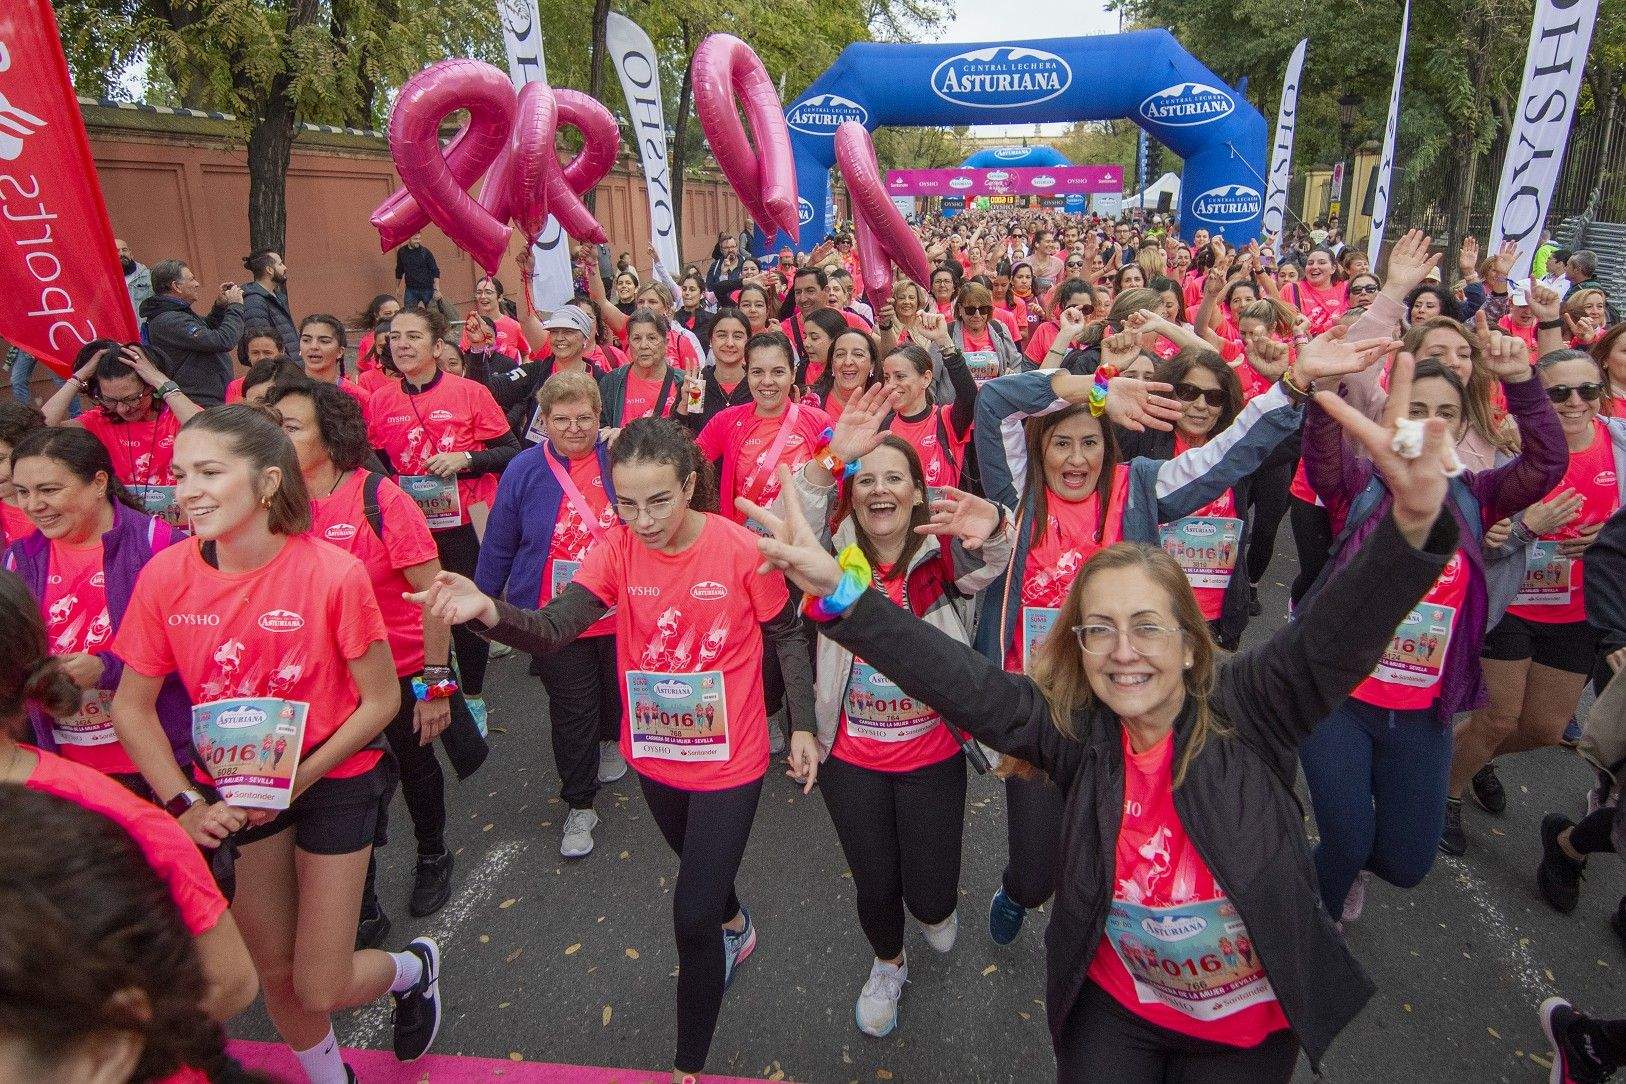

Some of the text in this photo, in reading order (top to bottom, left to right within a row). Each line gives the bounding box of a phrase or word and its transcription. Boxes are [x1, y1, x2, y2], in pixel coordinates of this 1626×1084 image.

[963, 62, 1057, 72] CENTRAL LECHERA
[941, 66, 1061, 93] ASTURIANA
[1147, 100, 1230, 118] ASTURIANA
[1501, 0, 1580, 243] OYSH
[1264, 84, 1296, 236] OYSHO
[1196, 199, 1259, 214] ASTURIANA
[387, 415, 411, 424] OYSHO
[1185, 547, 1217, 559] 016
[167, 613, 221, 626] OYSHO
[1393, 636, 1416, 653] 16
[656, 685, 691, 695] ASTURIANA
[875, 698, 913, 712] 016
[217, 714, 265, 726] ASTURIANA
[660, 711, 694, 727] 016
[857, 726, 887, 738] OYSHO
[213, 743, 257, 765] 016
[643, 744, 671, 755] OYSHO
[687, 748, 718, 756] Santander
[224, 777, 246, 786] MUJER
[249, 776, 275, 786] SEVILLA
[233, 790, 276, 801] Santander
[1145, 920, 1204, 937] ASTURIANA
[1161, 953, 1222, 977] 016
[1178, 990, 1190, 1000] DE
[1189, 992, 1200, 1001] LA
[1200, 988, 1226, 999] MUJER
[1231, 974, 1259, 991] SEVILLA
[1222, 984, 1270, 1009] Santander
